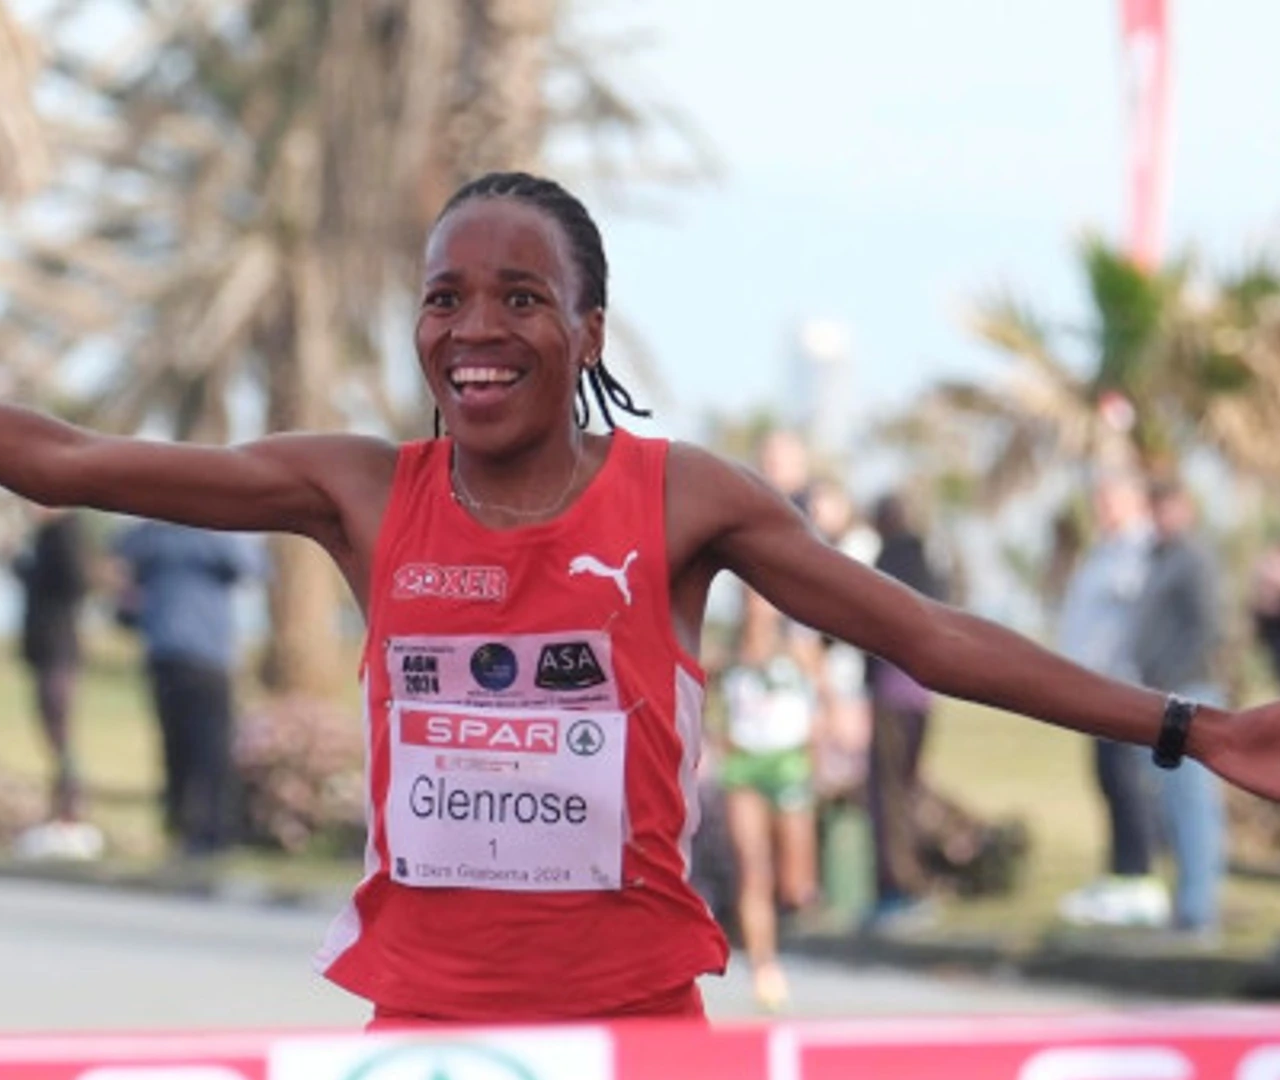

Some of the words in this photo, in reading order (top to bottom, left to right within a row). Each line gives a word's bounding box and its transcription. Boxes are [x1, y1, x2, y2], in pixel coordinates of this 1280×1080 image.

[542, 645, 596, 670] ASA
[425, 715, 556, 749] SPAR
[409, 774, 588, 824] Glenrose
[488, 837, 499, 860] 1
